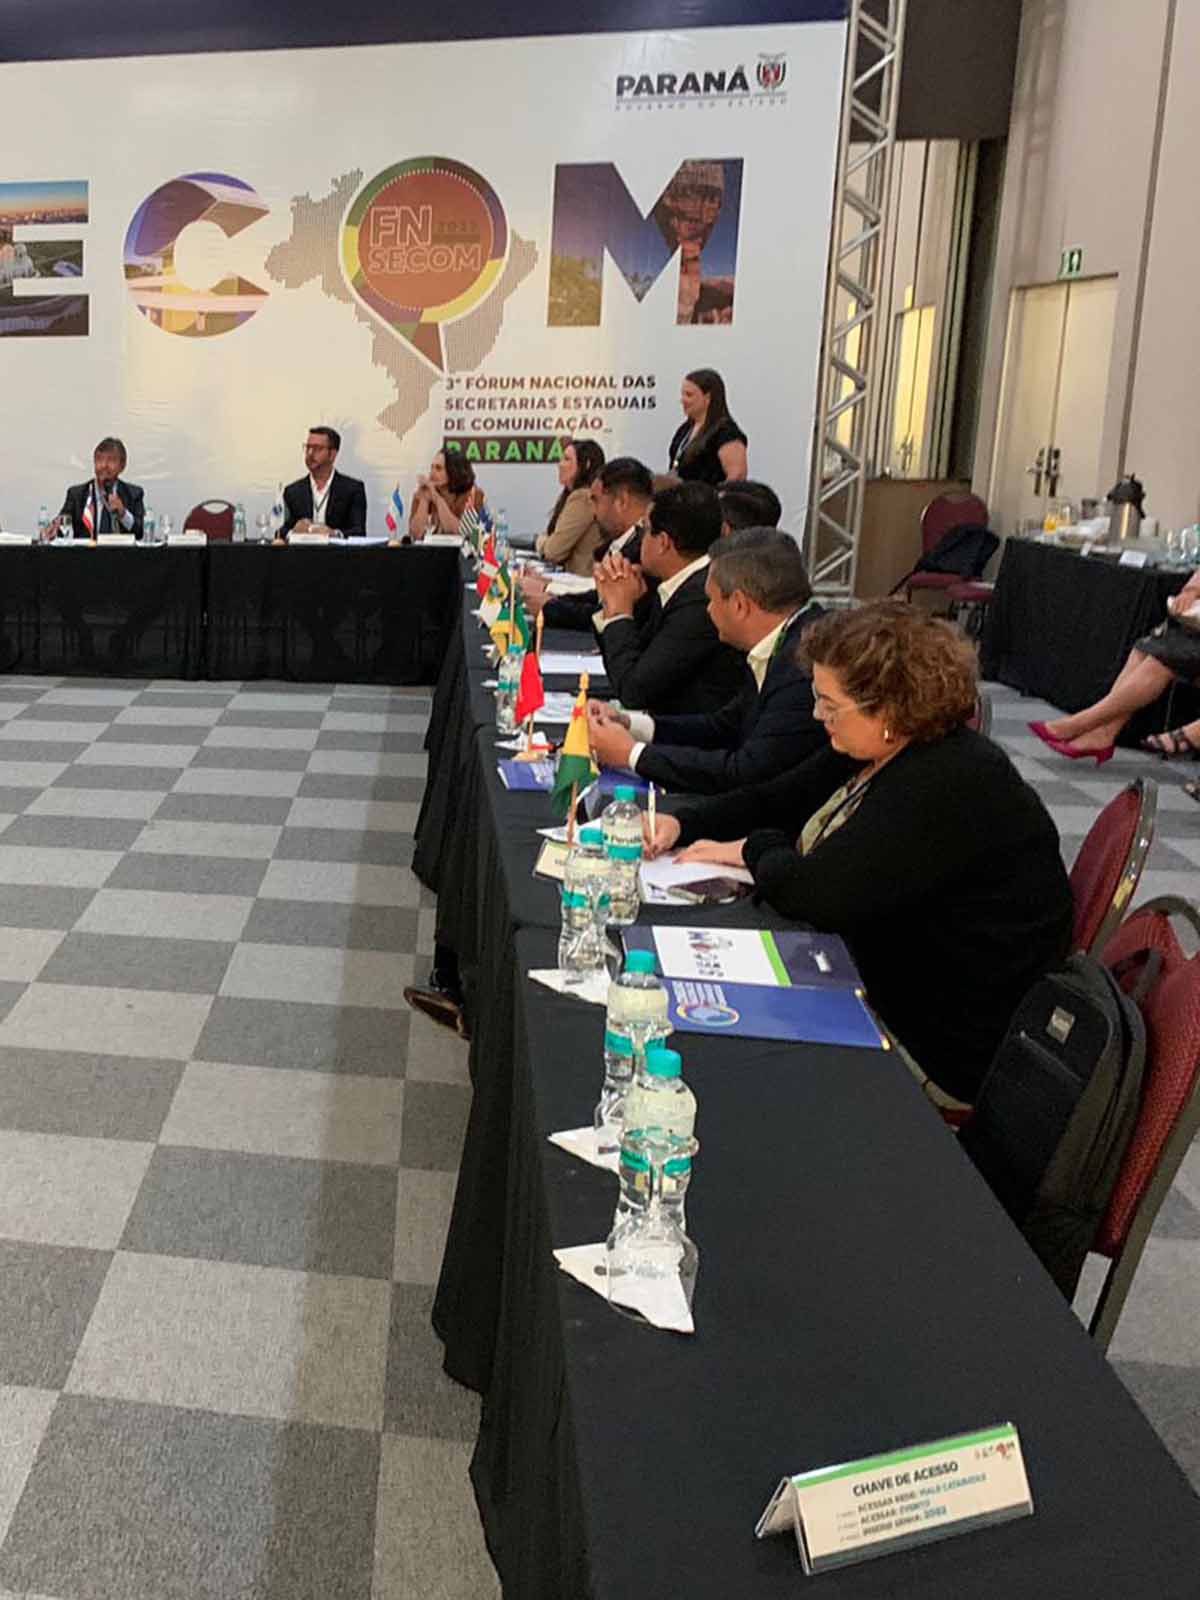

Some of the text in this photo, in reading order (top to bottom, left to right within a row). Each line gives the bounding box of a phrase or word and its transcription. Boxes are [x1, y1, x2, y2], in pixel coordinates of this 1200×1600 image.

[616, 64, 750, 97] PARANÁ
[369, 204, 433, 247] FN
[368, 244, 482, 274] SECOM
[465, 373, 526, 391] FÓRUM
[530, 375, 618, 390] NACIONAL
[622, 374, 657, 390] DAS
[445, 395, 657, 412] SECRETARIAS ESTADUAIS
[443, 416, 466, 432] DE
[852, 1460, 959, 1498] CHAVE DE ACESSO
